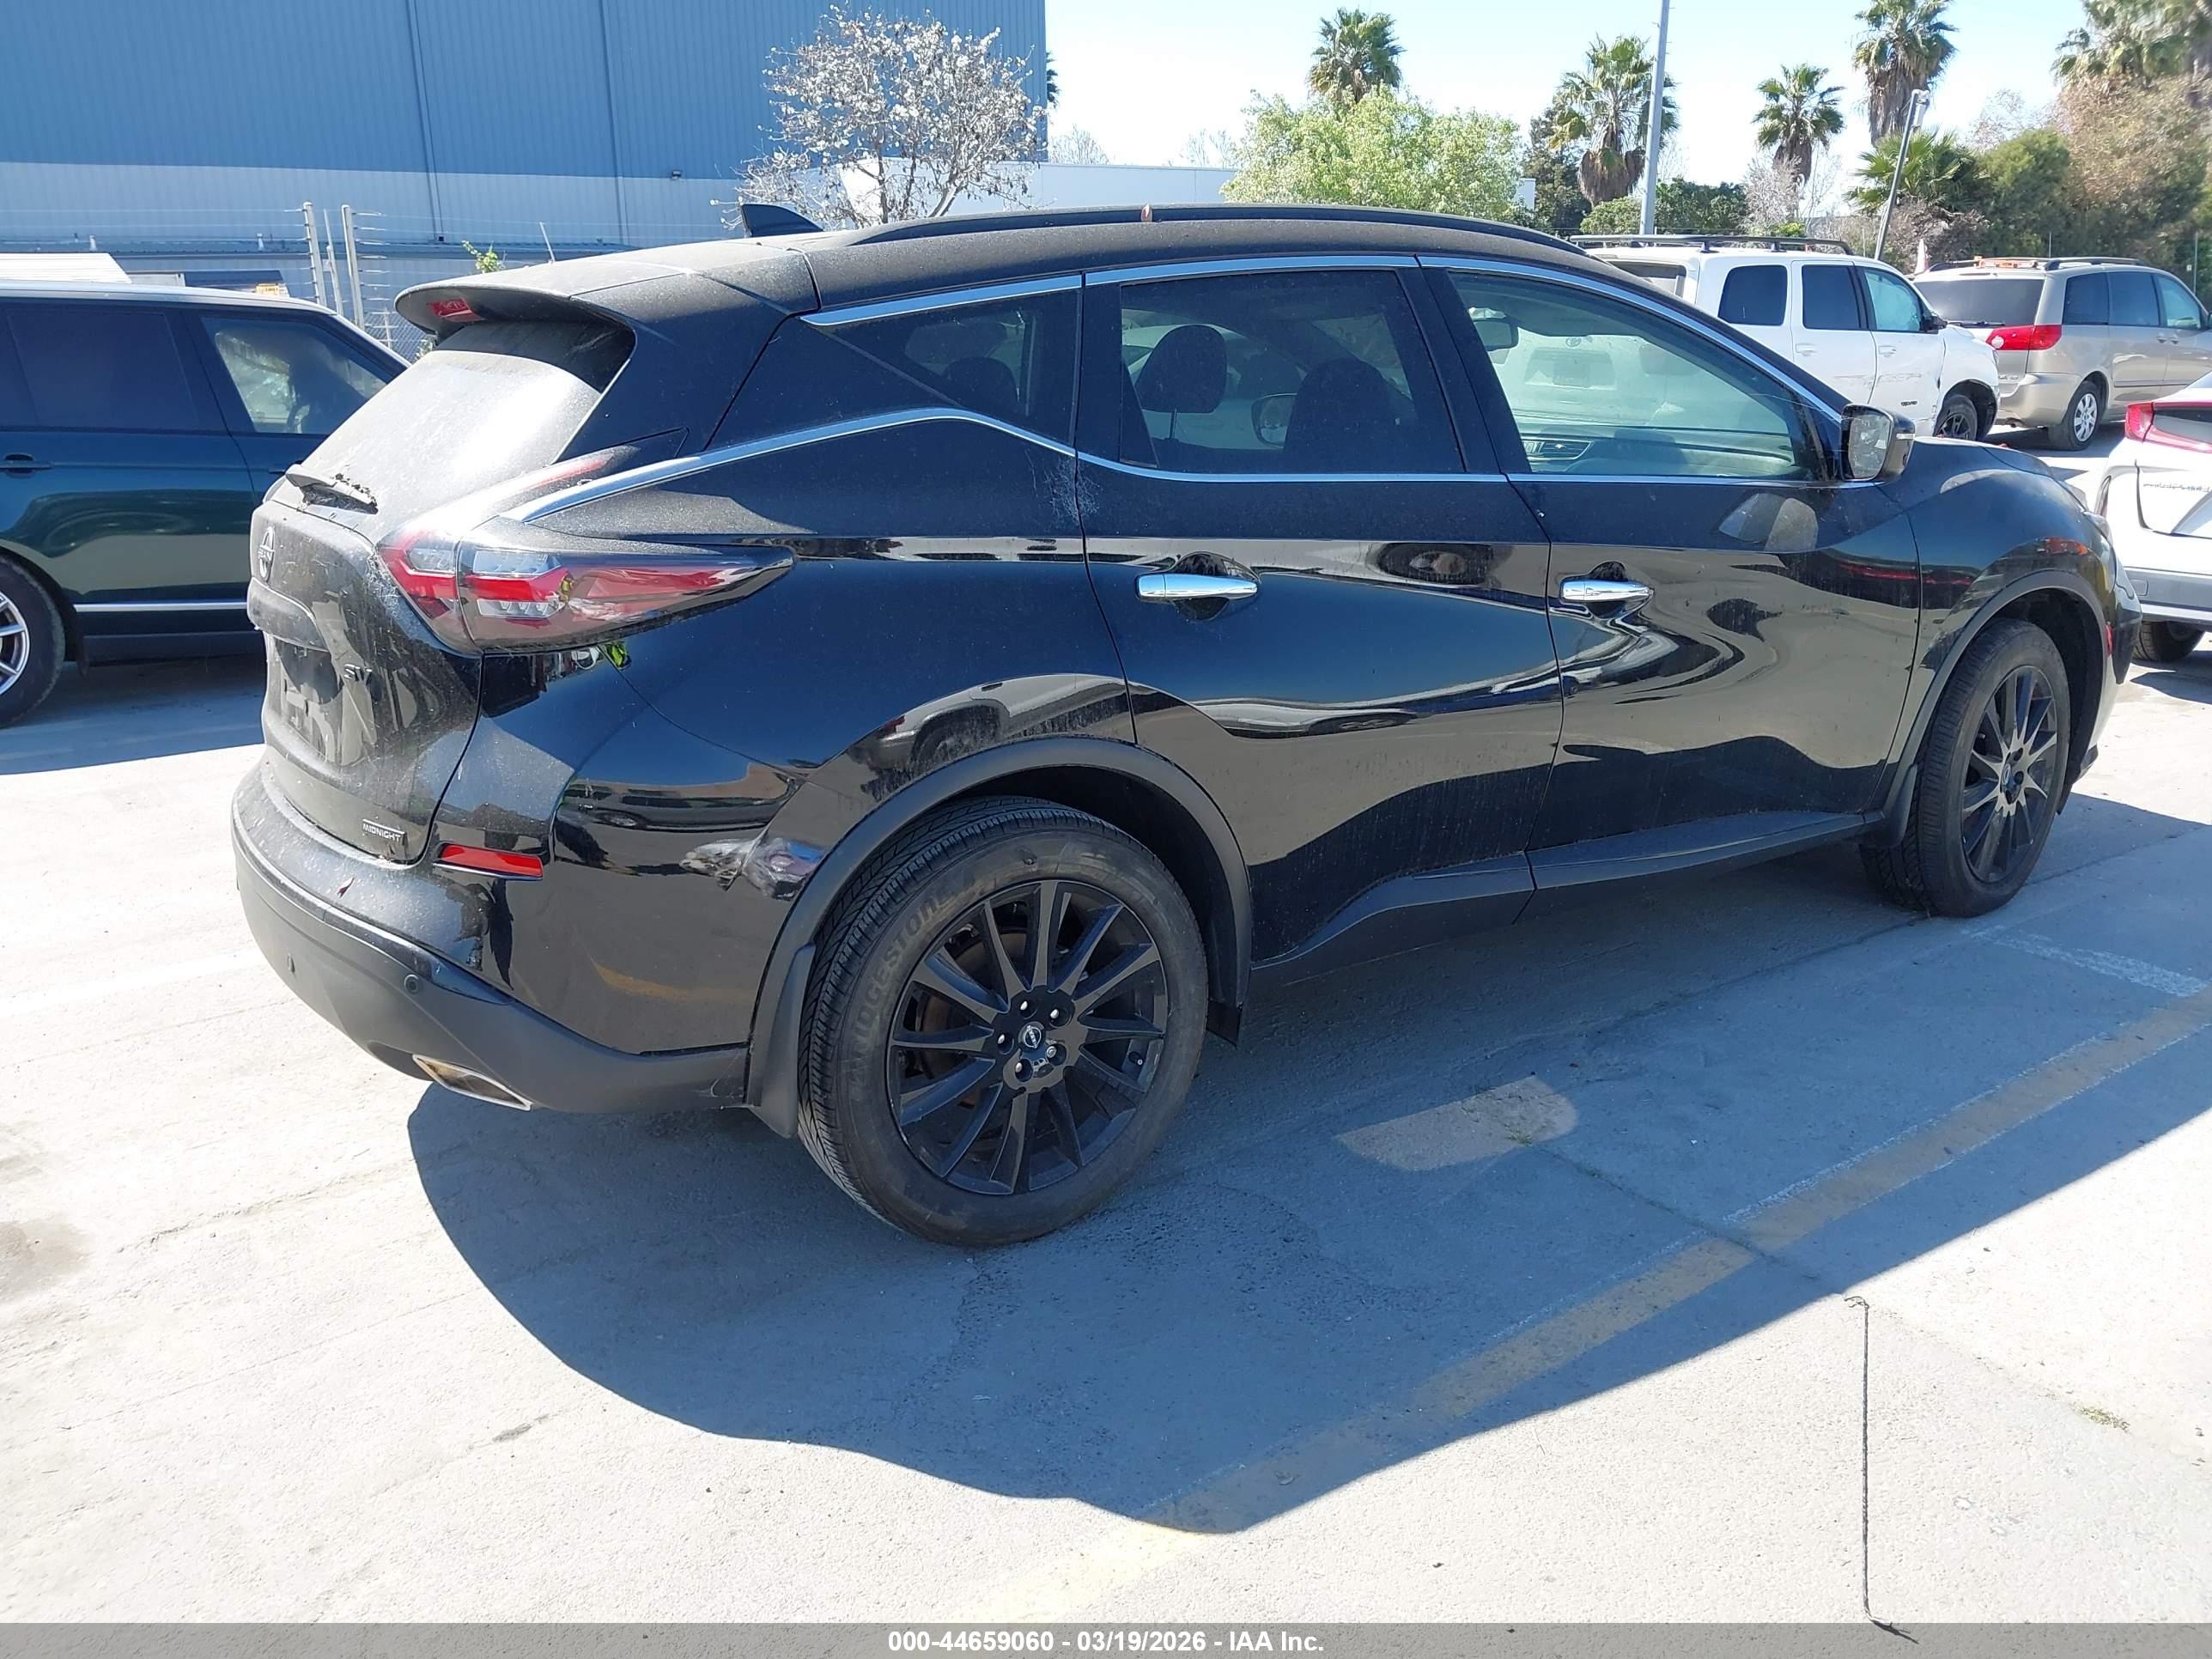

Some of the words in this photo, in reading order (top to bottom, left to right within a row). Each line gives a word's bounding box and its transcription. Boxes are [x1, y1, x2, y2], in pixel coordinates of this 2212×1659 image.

[343, 663, 373, 685] SV
[362, 823, 401, 842] MIDNIGHT
[848, 883, 955, 1082] RIDGESTONE
